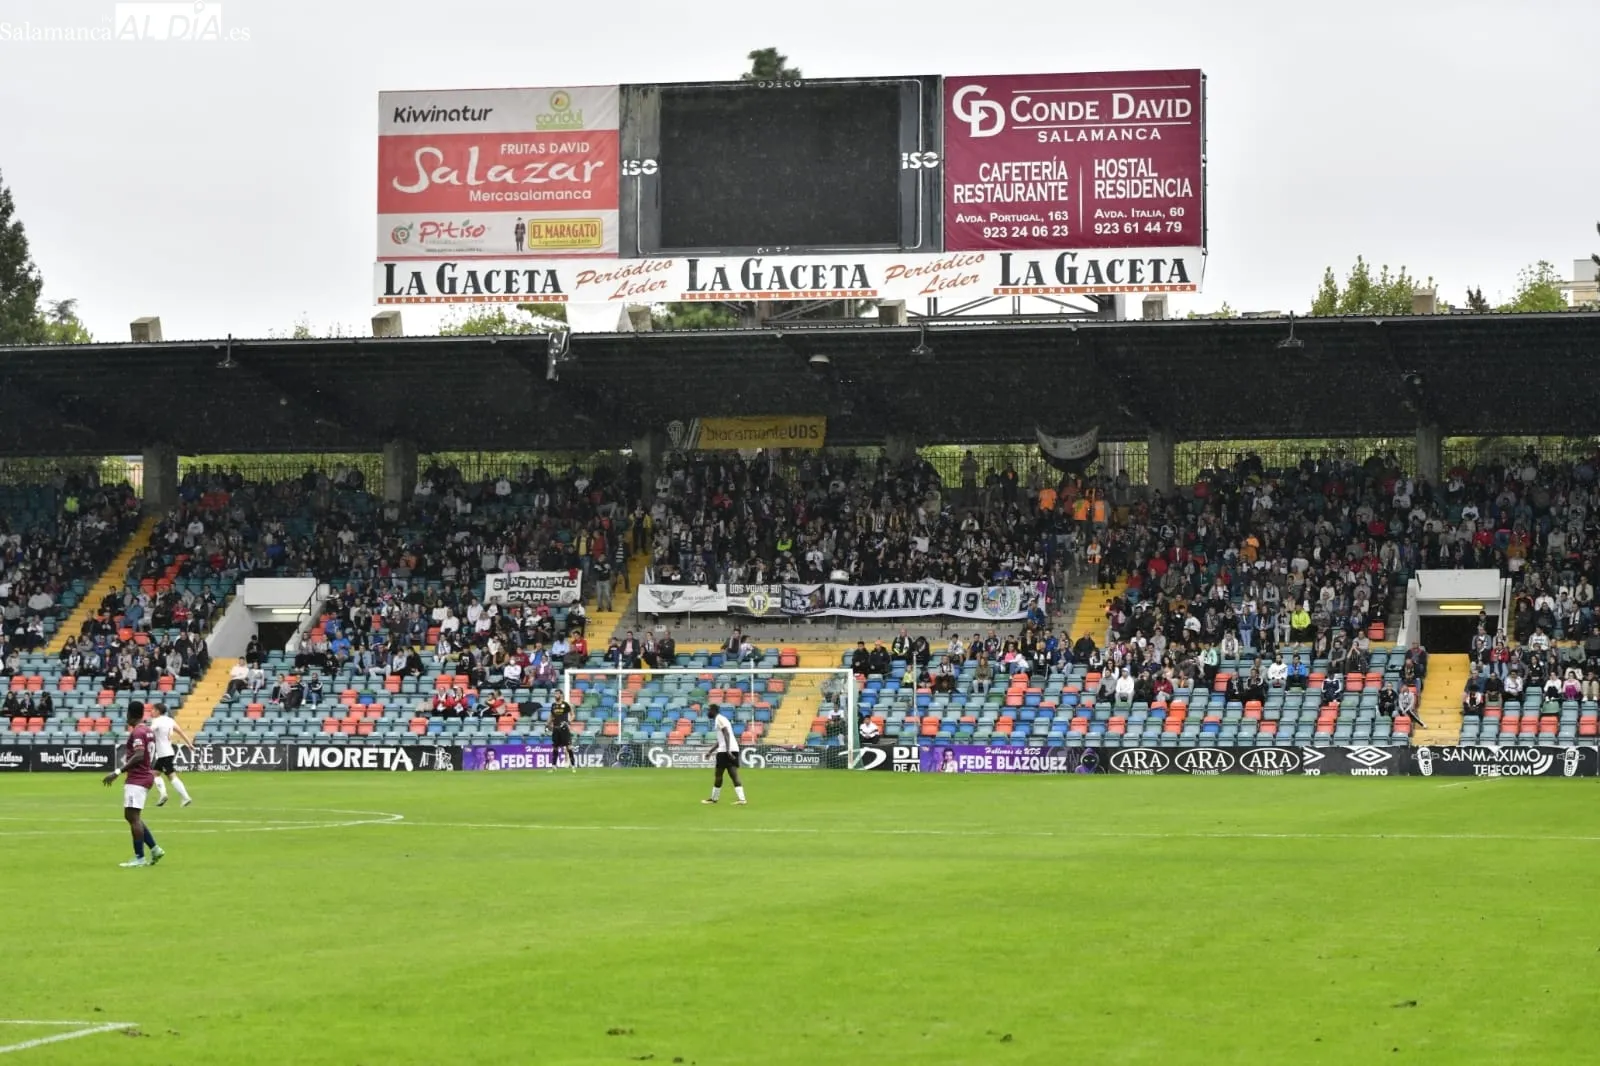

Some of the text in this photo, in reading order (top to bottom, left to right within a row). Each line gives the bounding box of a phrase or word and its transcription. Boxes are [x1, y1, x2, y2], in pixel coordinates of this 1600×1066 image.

[393, 105, 493, 123] Kiwinatur
[1011, 92, 1192, 122] CONDE DAVID
[1037, 128, 1161, 143] SALAMANCA
[501, 142, 590, 155] FRUTAS DAVID
[622, 159, 658, 176] ISO
[901, 151, 939, 169] ISO
[979, 156, 1068, 182] CAFETERÍA
[1094, 158, 1158, 178] HOSTAL
[392, 146, 605, 193] Salazar
[469, 189, 592, 202] Mercasalamanca
[953, 182, 1069, 204] RESTAURANTE
[1094, 178, 1193, 199] RESIDENCIA
[1048, 211, 1069, 221] 163
[1169, 207, 1185, 217] 60
[419, 219, 487, 242] Pitiso
[532, 223, 597, 239] EL MARAGATO
[983, 226, 1069, 238] 923 24 06 23
[1094, 222, 1182, 234] 923 61 44 79
[575, 259, 674, 290] Periódico
[687, 257, 872, 292] LA GACETA
[884, 253, 985, 284] Periódico
[999, 251, 1191, 286] LA GACETA
[384, 262, 563, 296] LA GACETA
[919, 272, 980, 295] Líder
[608, 279, 668, 300] Líder
[493, 577, 579, 590] SNTIMIENTO
[508, 591, 560, 601] CHARRO
[826, 588, 945, 611] ALAMANCA
[951, 590, 979, 613] 19
[171, 744, 214, 764] AFÉ
[221, 746, 282, 767] REAL
[297, 747, 414, 772] MORETA
[501, 754, 533, 768] FEDE
[765, 753, 820, 763] CONDE DAVID
[959, 755, 1067, 771] FEDE BLAZQUEZ
[1119, 751, 1162, 769] ARA
[1184, 751, 1227, 769] ARA
[1249, 750, 1293, 769] ARA
[1350, 766, 1388, 776] umbro
